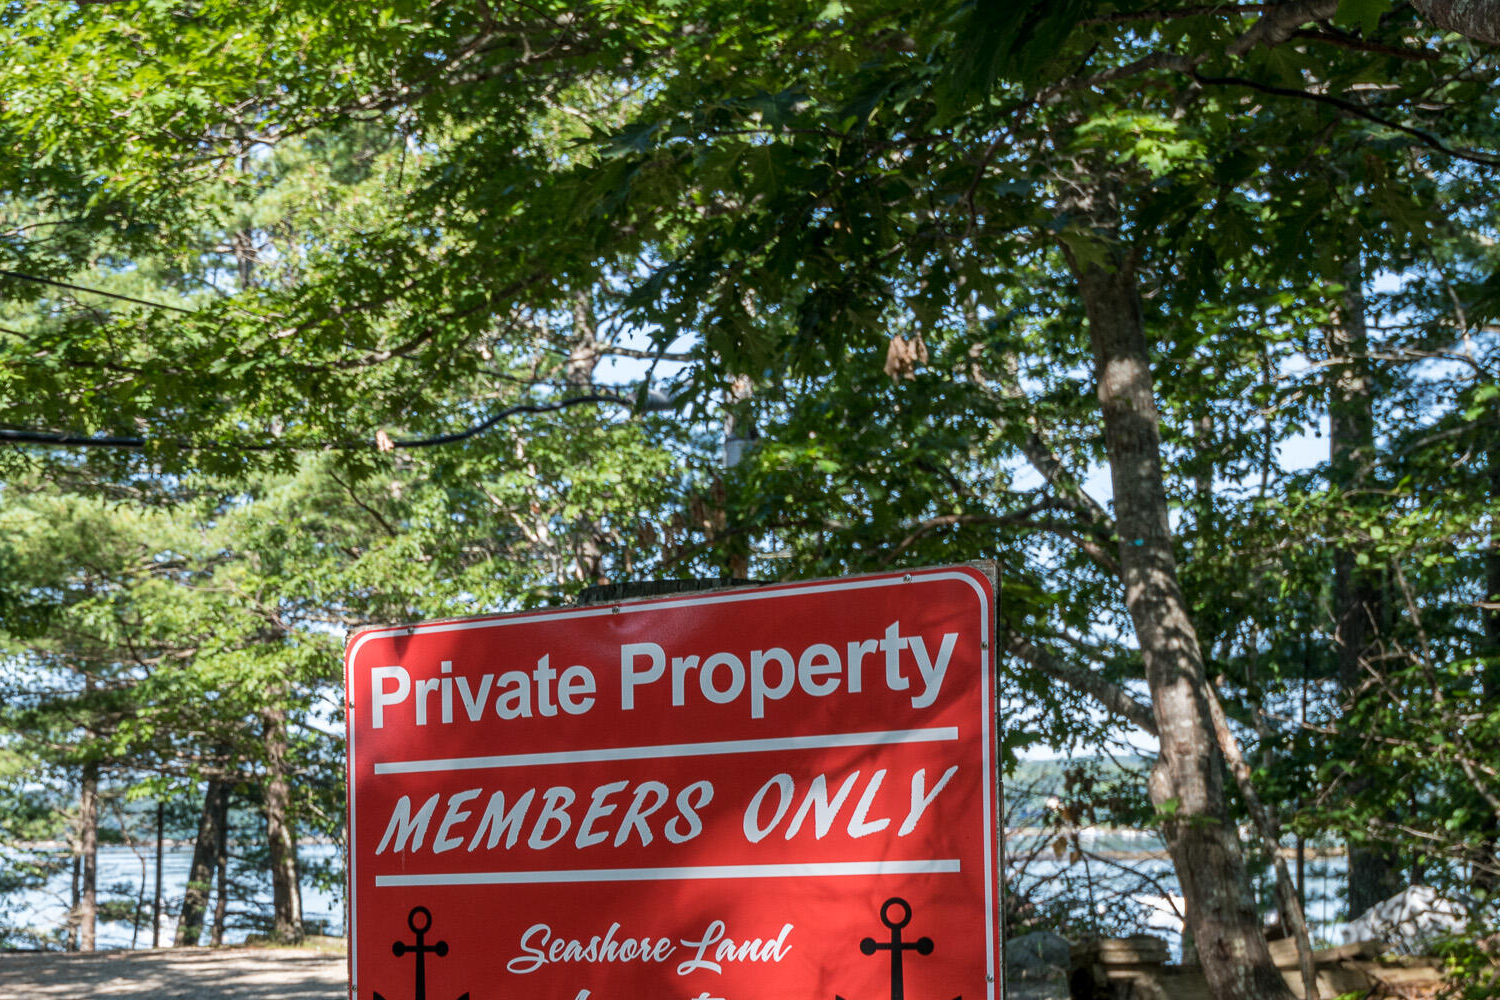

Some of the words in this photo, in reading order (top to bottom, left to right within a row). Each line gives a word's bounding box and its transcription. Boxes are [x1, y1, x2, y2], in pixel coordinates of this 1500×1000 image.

[371, 653, 596, 729] Private
[621, 621, 959, 719] Property
[375, 780, 714, 855] MEMBERS
[742, 766, 959, 843] ONLY
[507, 922, 677, 974] Seashore
[677, 920, 794, 975] Land
